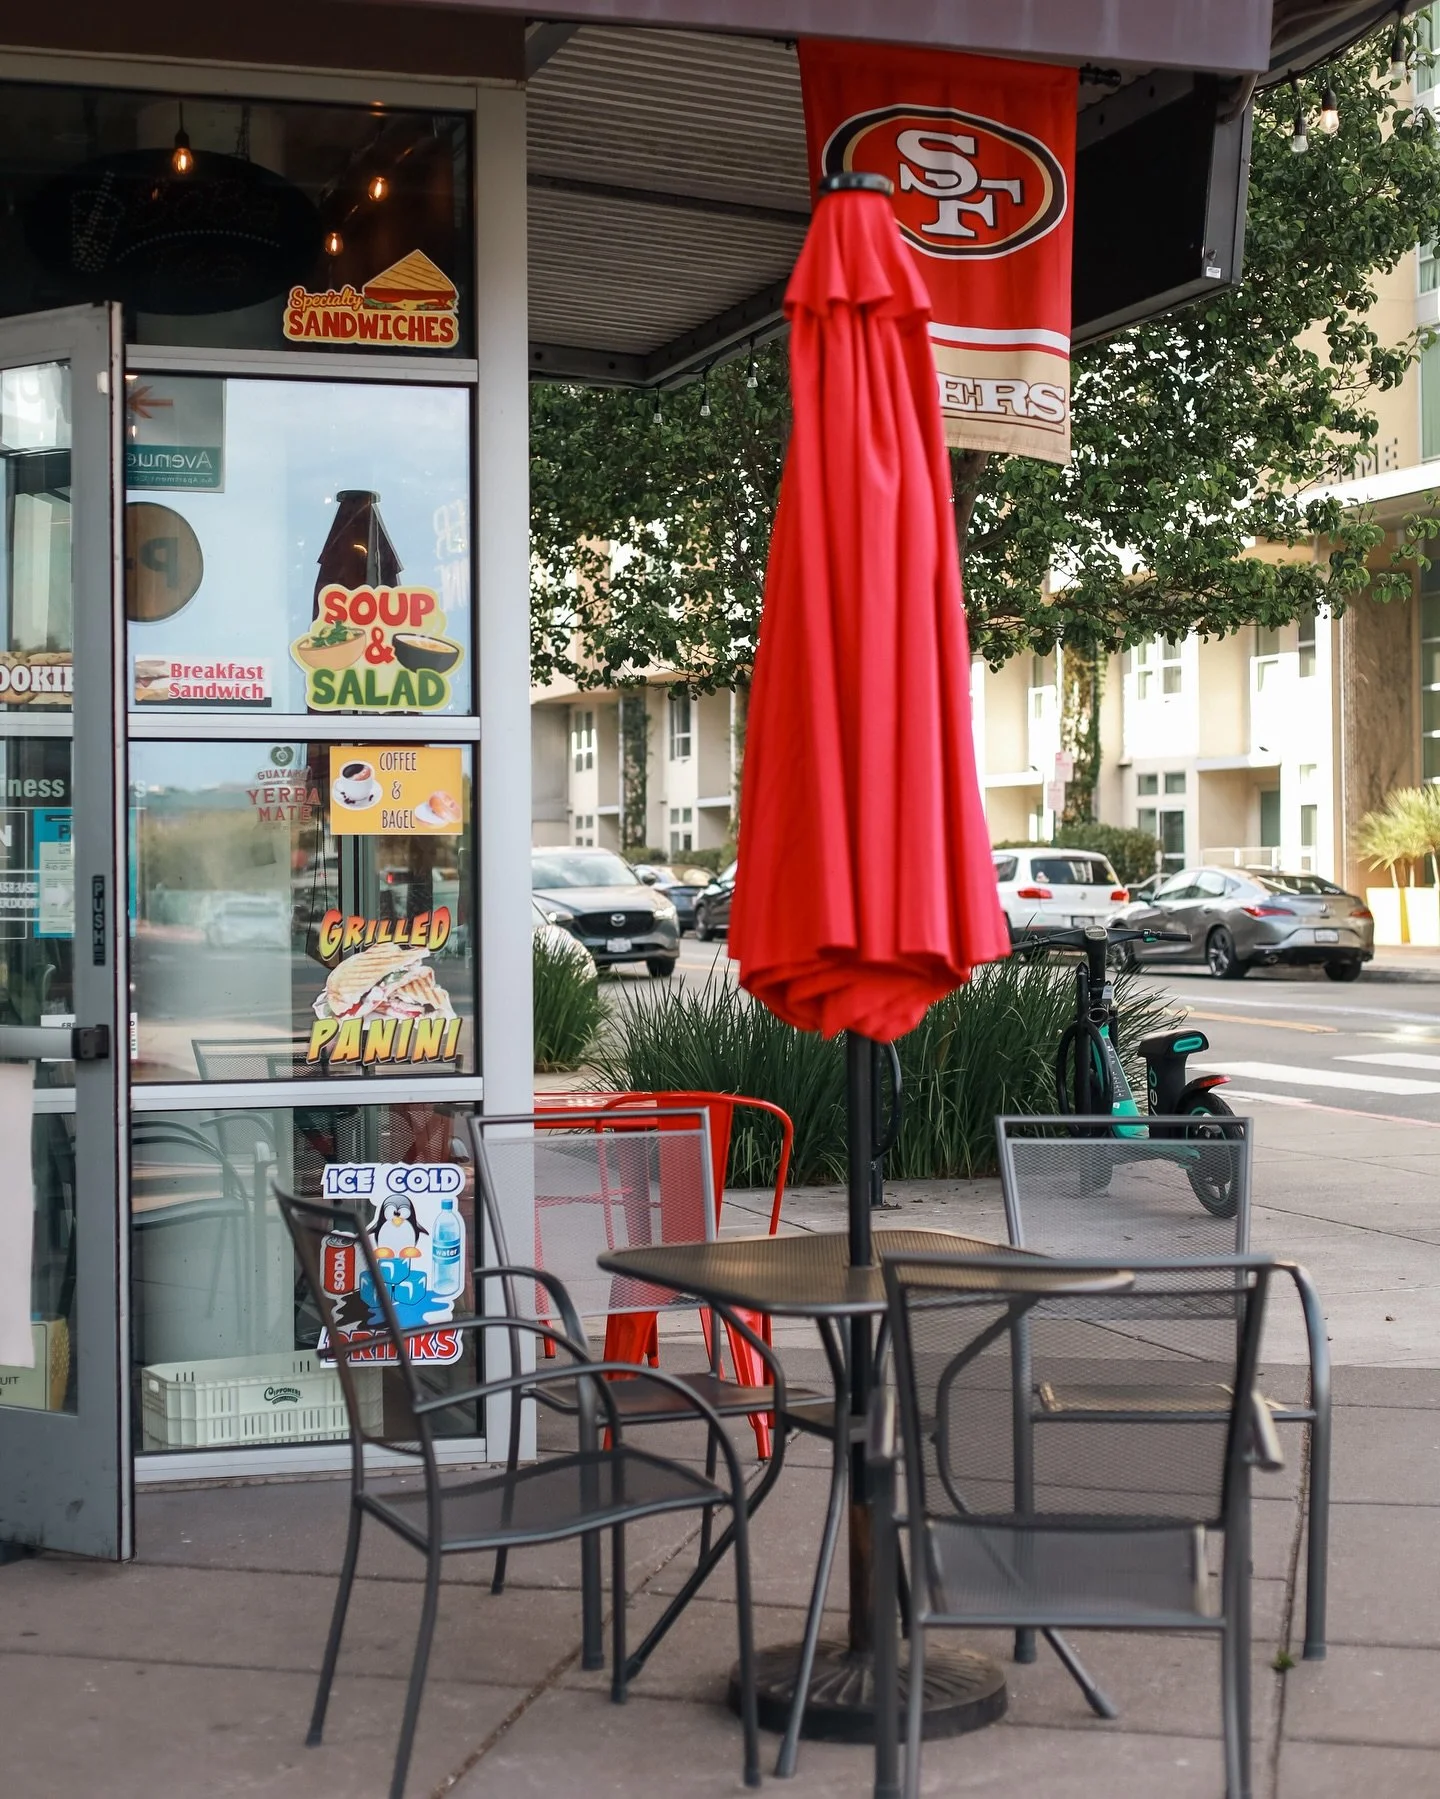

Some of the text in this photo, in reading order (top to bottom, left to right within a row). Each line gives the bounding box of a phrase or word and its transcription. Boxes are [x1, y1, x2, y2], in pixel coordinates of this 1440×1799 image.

[896, 129, 1022, 238] SF
[290, 287, 363, 311] Specialty
[288, 310, 454, 343] SANDWICHES
[324, 591, 435, 627] SOUP
[364, 626, 395, 665] &
[170, 663, 264, 680] Breakfast
[168, 682, 264, 699] Sandwich
[312, 669, 446, 707] SALAD
[380, 752, 417, 771] COFFEE
[246, 787, 321, 806] YERBA
[391, 781, 402, 800] &
[257, 805, 313, 822] MATE
[382, 809, 415, 829] BAGEL
[93, 882, 105, 945] PUSH
[319, 906, 452, 961] GRILLED
[306, 1017, 464, 1066] PANINI
[327, 1167, 461, 1194] ICE COLD
[435, 1248, 459, 1258] water
[333, 1250, 346, 1292] SODA
